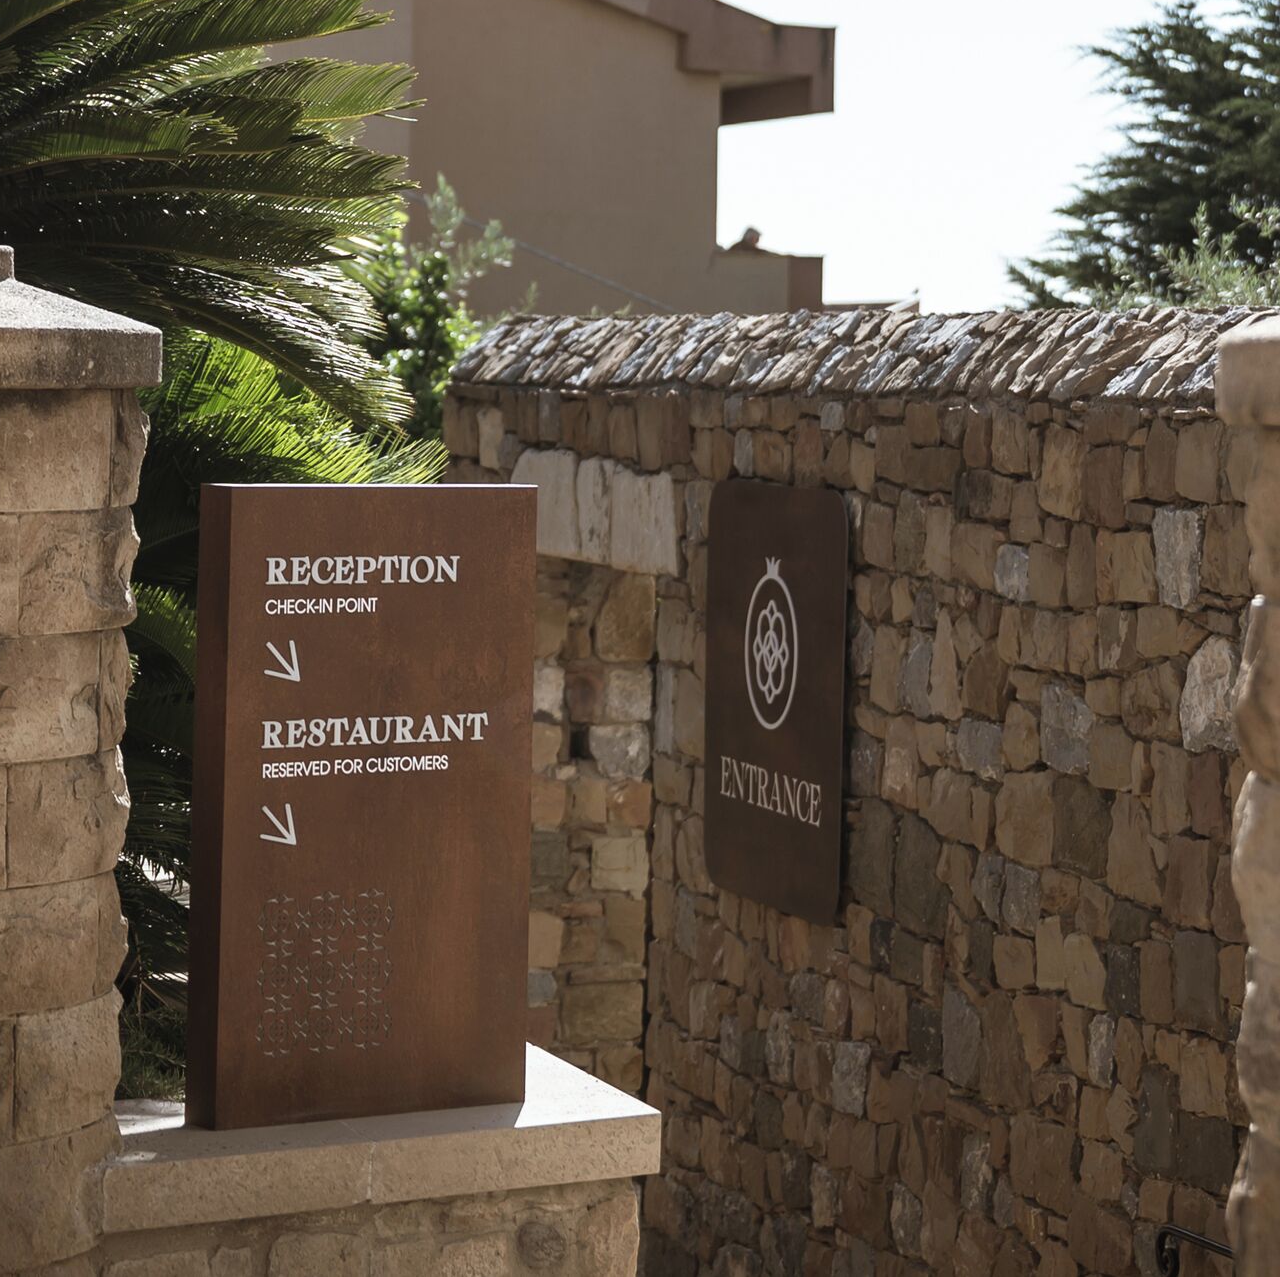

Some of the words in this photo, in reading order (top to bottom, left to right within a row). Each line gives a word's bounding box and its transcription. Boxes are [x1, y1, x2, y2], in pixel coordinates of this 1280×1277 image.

[265, 555, 460, 585] RECEPTION
[265, 598, 333, 615] CHECK-IN
[336, 597, 378, 613] POINT
[261, 712, 488, 749] RESTAURANT
[262, 760, 331, 779] RESERVED
[334, 758, 363, 775] FOR
[366, 755, 449, 773] CUSTOMERS
[720, 755, 821, 827] ENTRANCE
